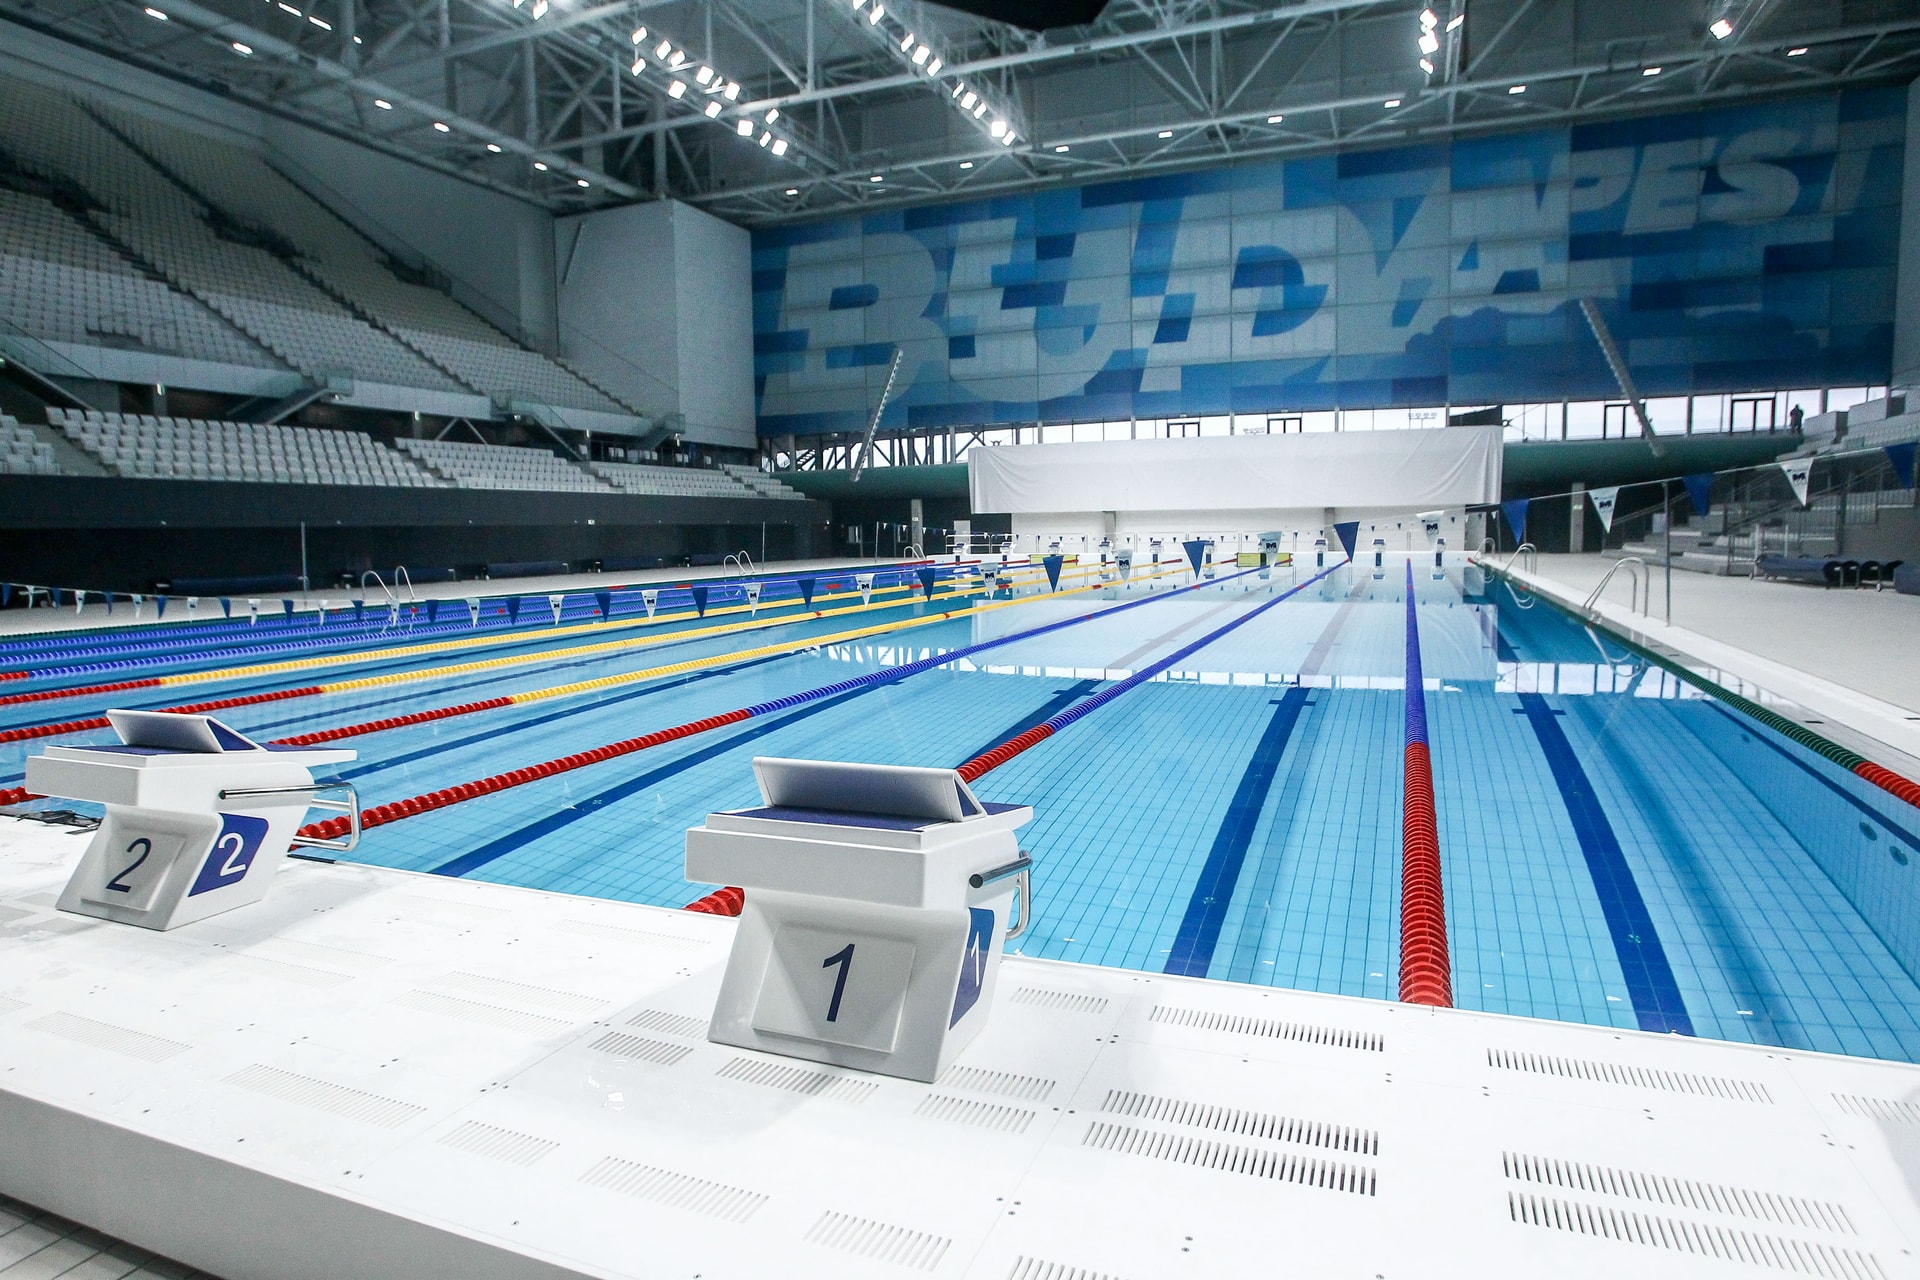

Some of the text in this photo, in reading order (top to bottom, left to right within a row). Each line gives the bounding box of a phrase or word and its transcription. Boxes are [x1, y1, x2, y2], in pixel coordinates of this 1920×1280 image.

[106, 837, 152, 893] 2
[218, 832, 247, 877] 2
[822, 943, 856, 1023] 1
[969, 931, 981, 987] 1
